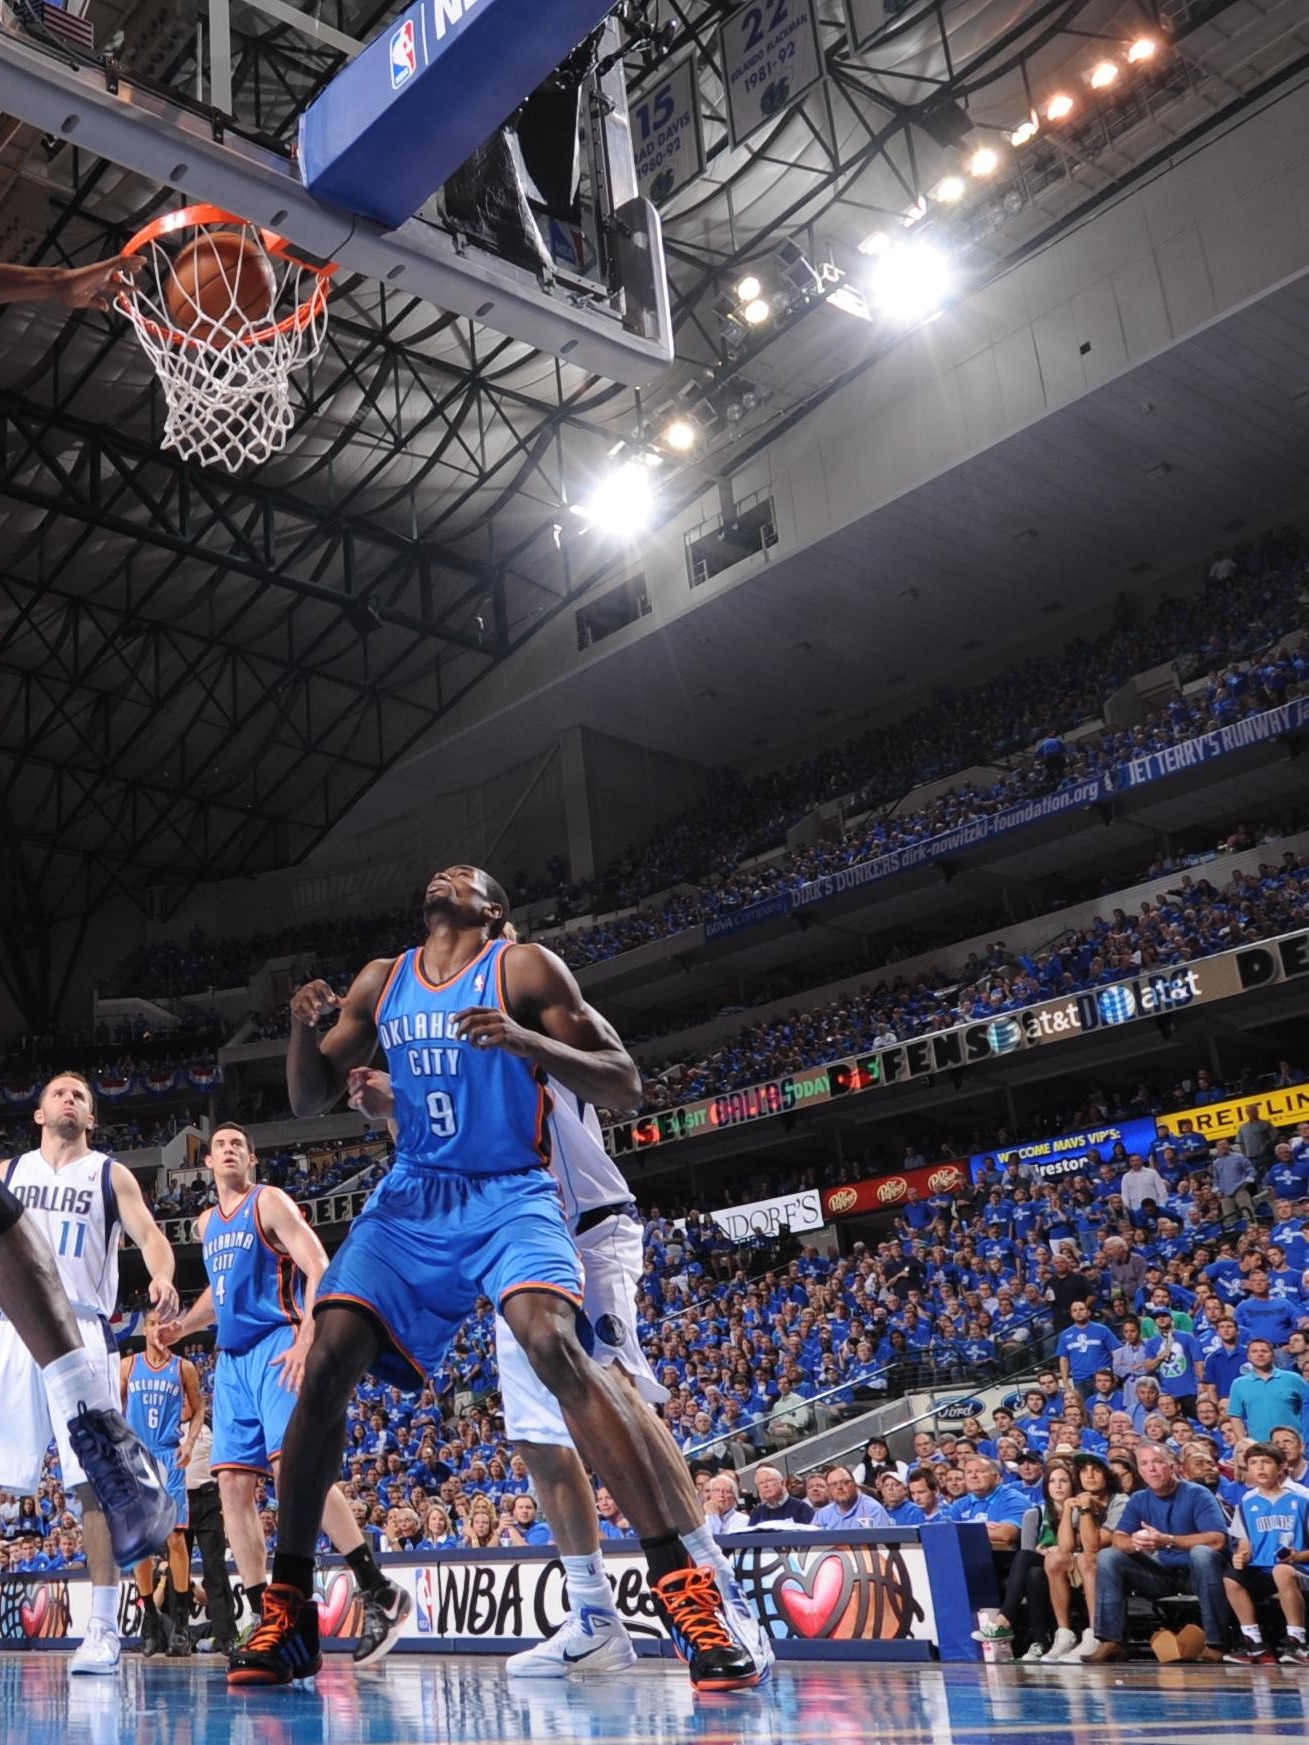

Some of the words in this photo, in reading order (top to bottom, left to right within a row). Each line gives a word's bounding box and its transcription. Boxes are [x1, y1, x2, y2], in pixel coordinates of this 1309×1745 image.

[742, 0, 789, 53] 22
[744, 41, 797, 93] 1981-92
[636, 84, 675, 140] 15
[657, 112, 690, 145] DAVIS
[1129, 756, 1154, 786] JET
[1155, 735, 1220, 775] TERRY'S
[1221, 706, 1291, 751] RUNWAY
[791, 877, 833, 908] DIRK'S
[836, 855, 900, 891] DUNKERS
[902, 781, 1099, 867] dirk-nowitzki-foundation.org
[1140, 970, 1202, 1009] at&t
[379, 1011, 468, 1050] OKLAHO
[1025, 1002, 1082, 1038] at&t
[408, 1048, 461, 1077] CITY
[425, 1090, 457, 1138] 9
[1053, 1136, 1086, 1152] MAVS
[14, 1185, 93, 1215] DALLAS
[58, 1220, 86, 1258] 11
[203, 1231, 254, 1258] OKLAHOMA
[212, 1252, 236, 1273] CITY
[215, 1275, 227, 1305] 4
[129, 1379, 180, 1397] OKLAHOMA
[142, 1392, 165, 1406] CITY
[147, 1408, 159, 1429] 6
[437, 1560, 523, 1637] NBA
